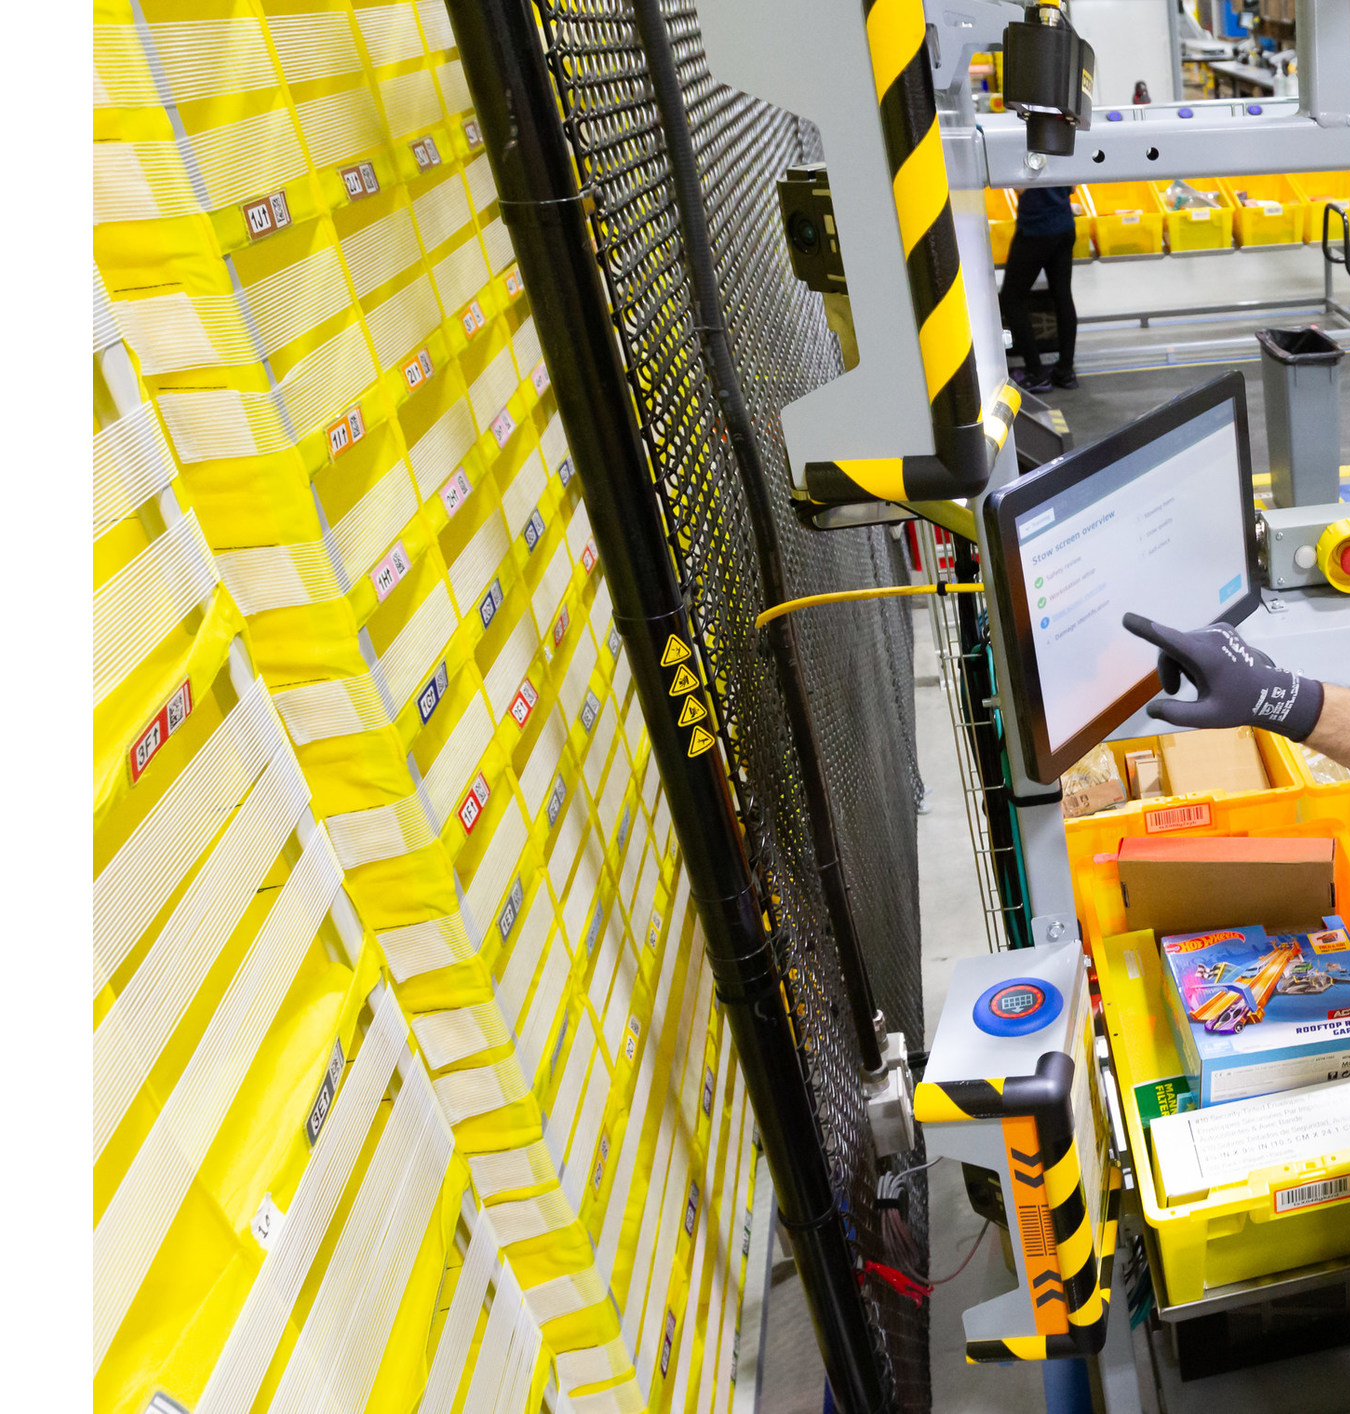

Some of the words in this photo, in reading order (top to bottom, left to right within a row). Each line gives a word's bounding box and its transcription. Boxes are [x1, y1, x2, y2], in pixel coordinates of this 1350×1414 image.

[250, 210, 264, 231] 1J
[1032, 548, 1053, 566] Stow
[1055, 532, 1081, 552] screen
[1082, 511, 1115, 535] overview
[138, 734, 152, 766] 3F
[1296, 1021, 1342, 1034] ROOFTOP
[1164, 1083, 1177, 1115] MANN
